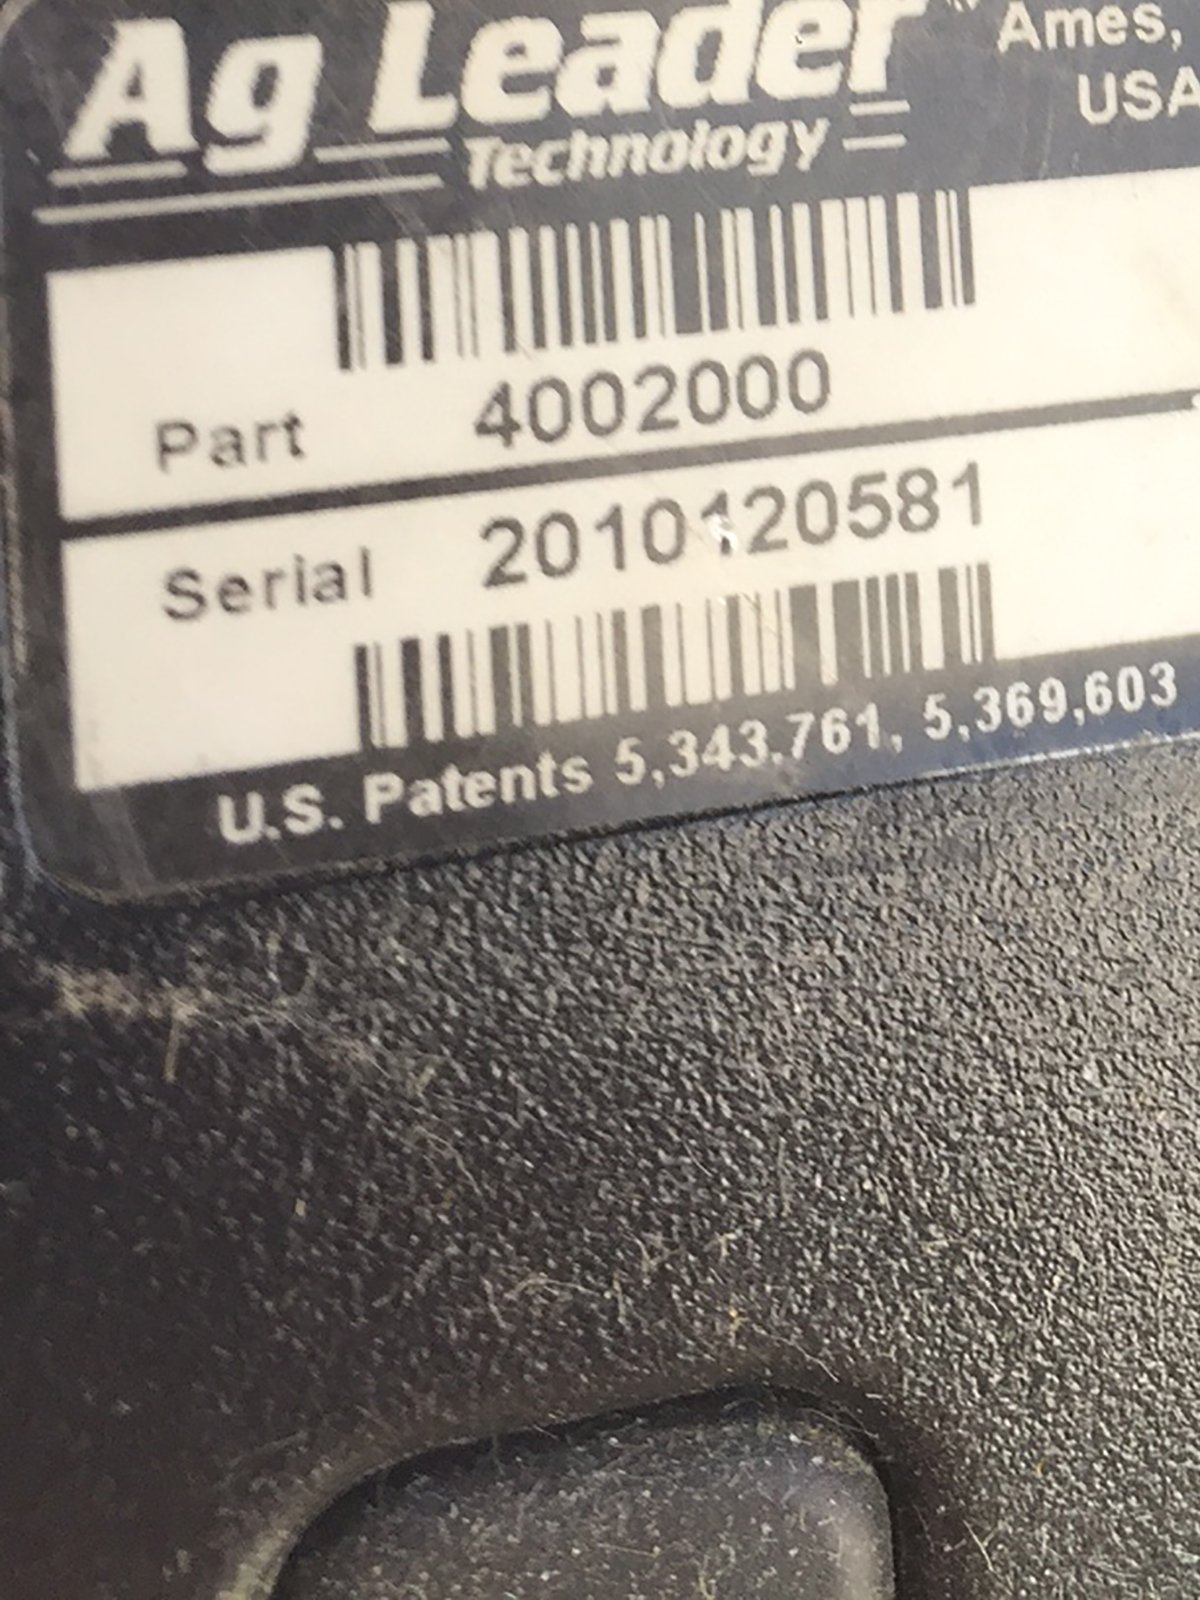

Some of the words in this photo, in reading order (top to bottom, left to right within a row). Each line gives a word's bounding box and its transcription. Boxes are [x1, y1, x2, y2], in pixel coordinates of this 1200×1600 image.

[62, 17, 322, 176] Ag
[997, 0, 1184, 53] Ames,
[463, 116, 830, 191] Technology
[155, 410, 306, 474] Part
[473, 348, 834, 448] 4002000
[163, 547, 375, 622] Serial
[478, 461, 988, 591] 2010120581
[217, 785, 344, 846] U.S.
[364, 749, 592, 824] Patents
[922, 660, 1179, 742] 5,369,603
